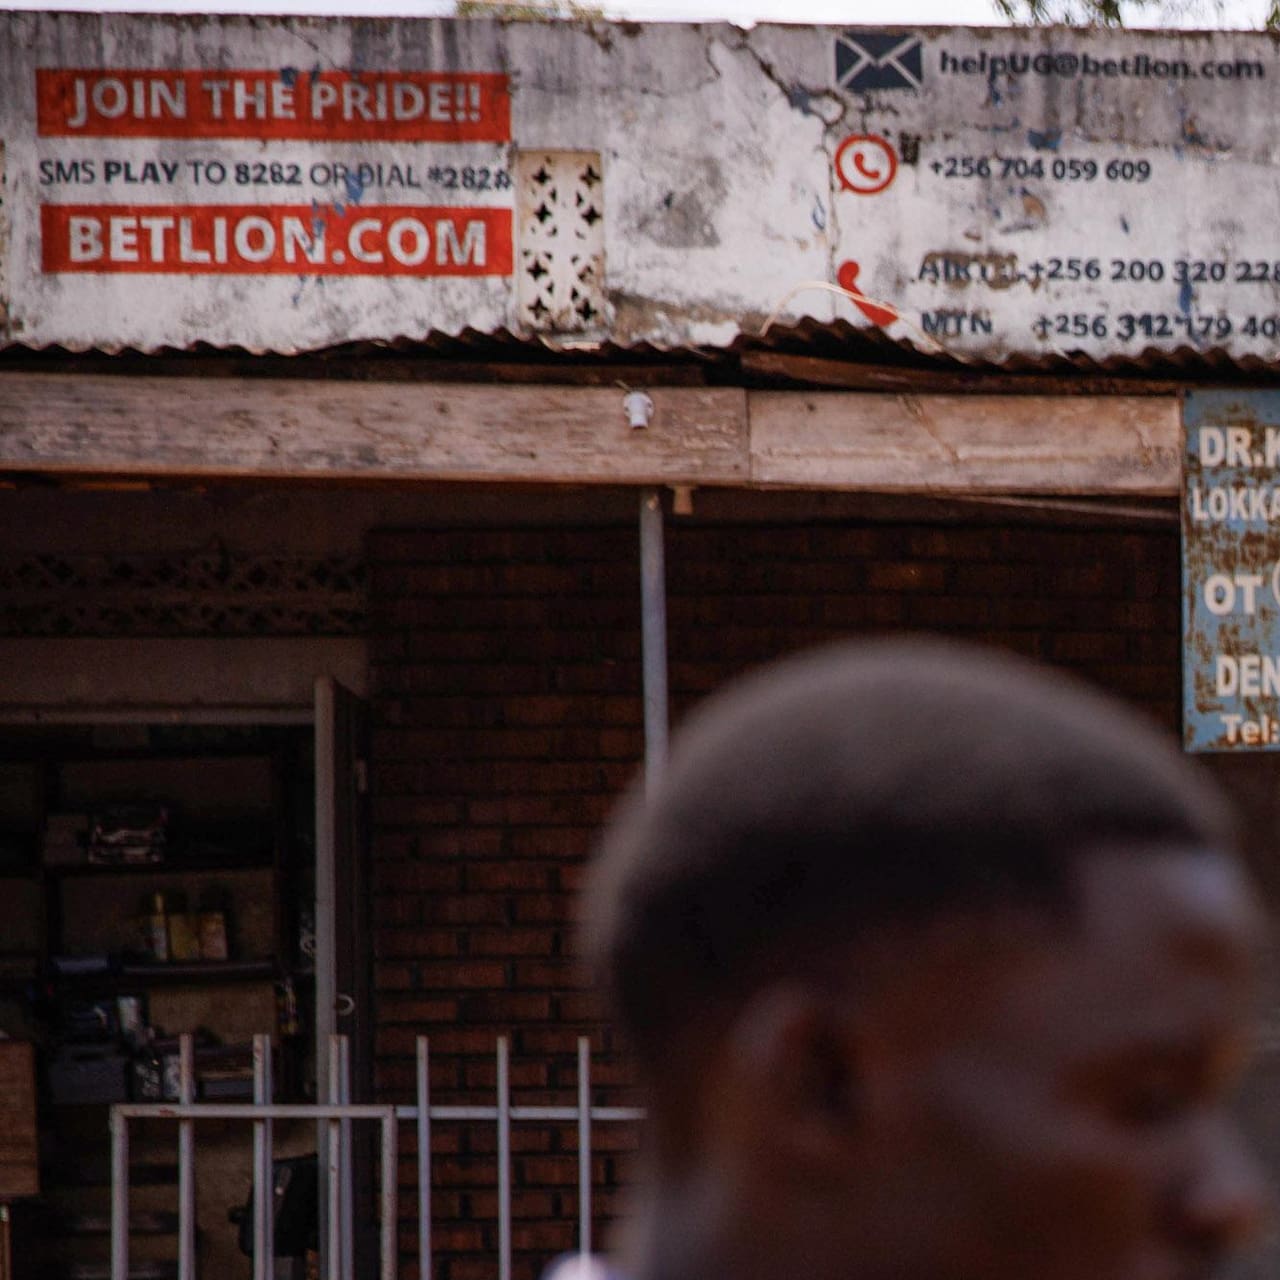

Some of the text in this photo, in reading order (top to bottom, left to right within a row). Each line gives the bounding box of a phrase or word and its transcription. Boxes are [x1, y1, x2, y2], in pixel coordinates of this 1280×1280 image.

[67, 78, 481, 128] JOIN THE PRIDE!!
[39, 160, 95, 186] SMS
[103, 160, 179, 183] PLAY
[186, 160, 226, 184] TO
[235, 164, 301, 185] 8282
[310, 163, 348, 187] OR
[358, 164, 420, 188] DIAL
[930, 157, 1151, 182] +256 704 059 609
[69, 216, 487, 266] BETLION.COM
[1029, 257, 1100, 282] +256
[1111, 260, 1164, 282] 200
[1173, 260, 1226, 283] 320
[921, 310, 992, 335] MTN
[1035, 313, 1107, 338] +256
[1203, 574, 1263, 616] OT
[1220, 713, 1279, 744] Tel:
